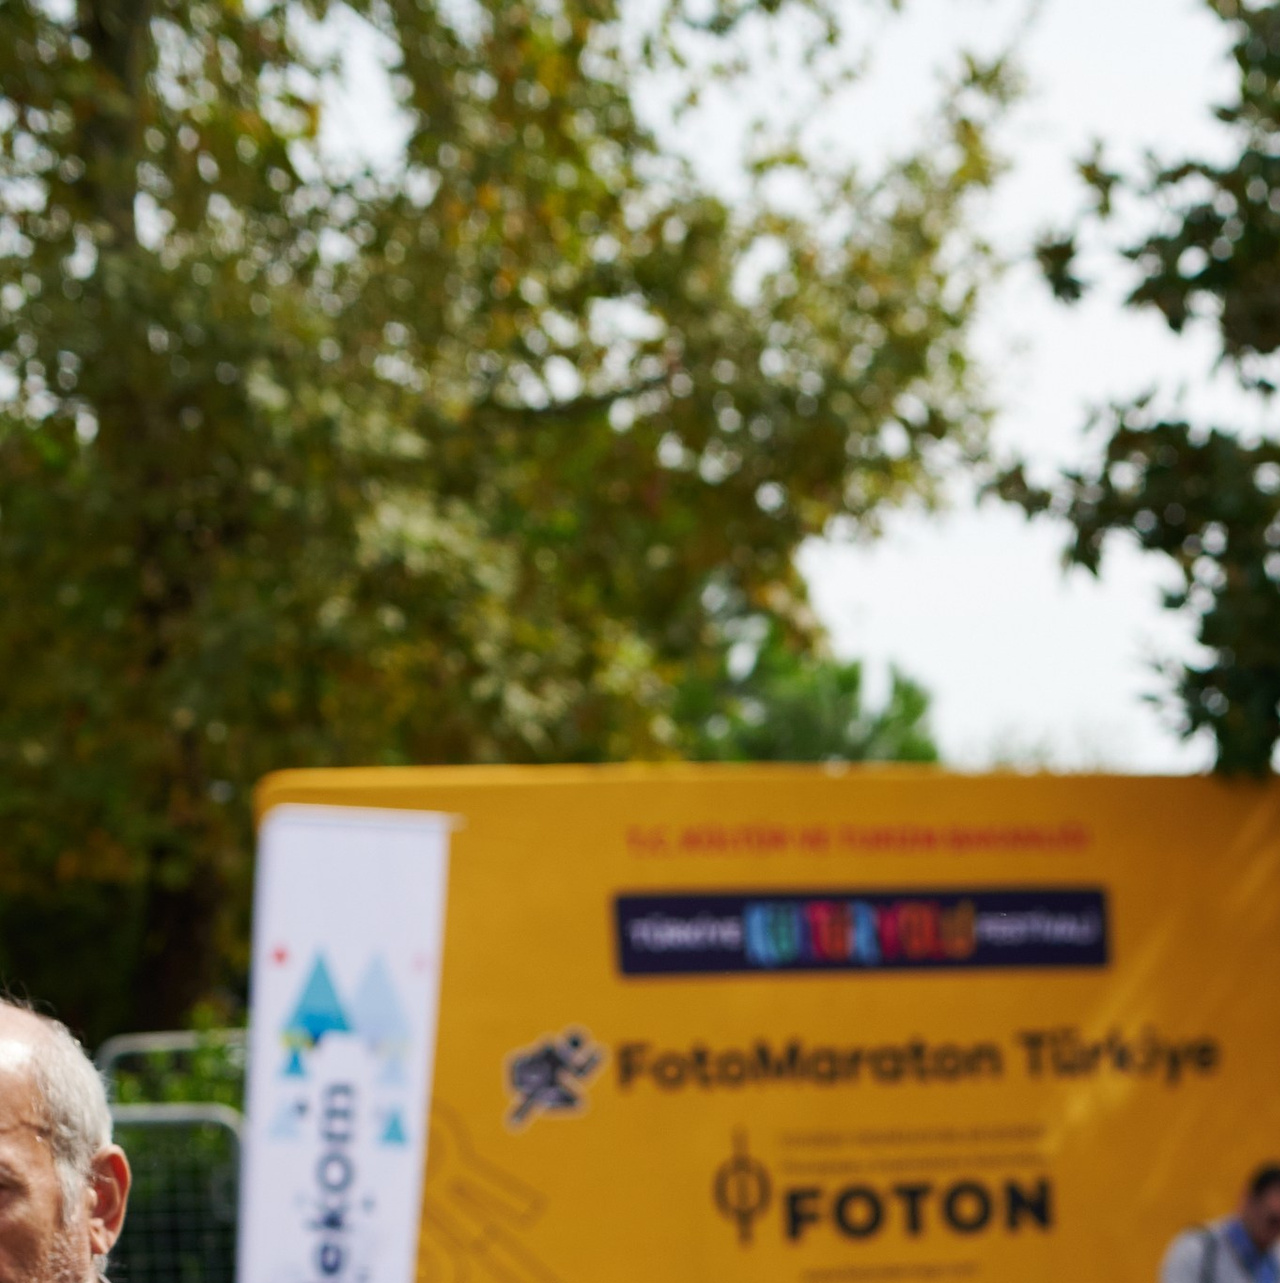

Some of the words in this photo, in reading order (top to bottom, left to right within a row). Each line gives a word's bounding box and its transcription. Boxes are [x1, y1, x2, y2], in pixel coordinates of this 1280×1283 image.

[616, 1034, 1004, 1092] FotoMaraton
[1013, 1024, 1221, 1090] Türkiye
[784, 1179, 1053, 1246] FOTON
